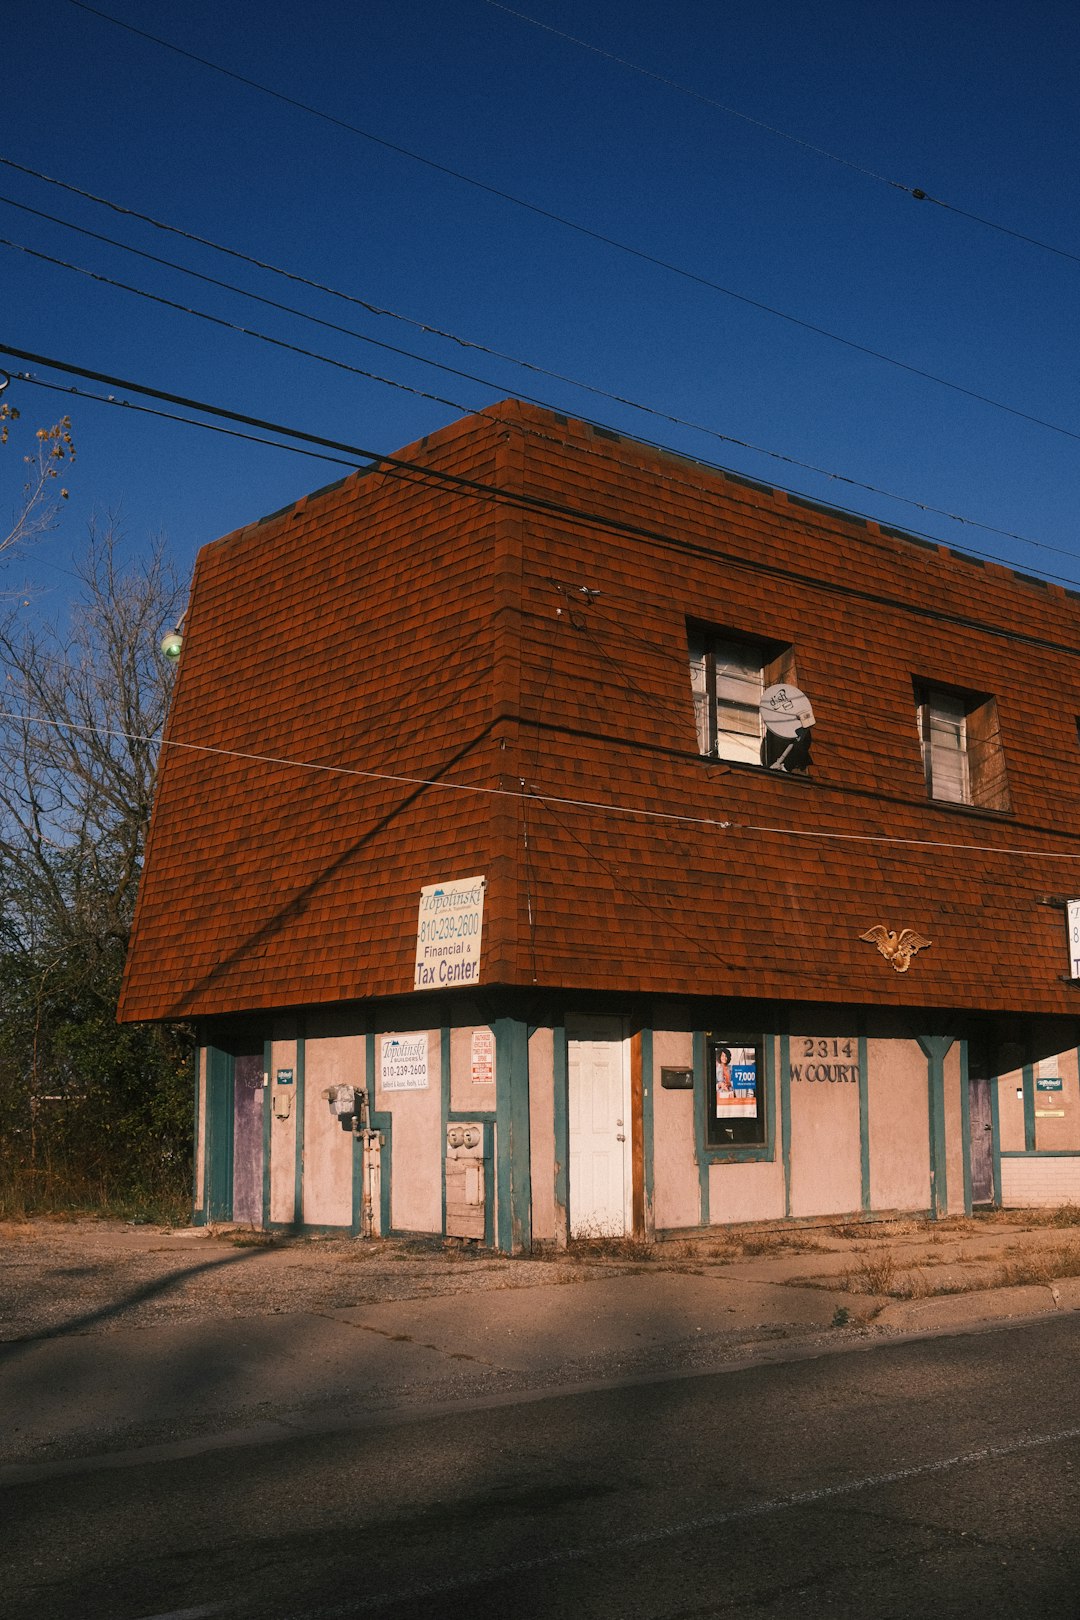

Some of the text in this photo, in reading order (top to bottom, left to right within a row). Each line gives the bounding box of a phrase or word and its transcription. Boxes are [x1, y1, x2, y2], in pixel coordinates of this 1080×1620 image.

[422, 885, 481, 914] Topolinski
[421, 913, 478, 942] 810-239-2600
[424, 942, 471, 958] Financial &
[417, 959, 477, 984] Tax Center
[383, 1039, 426, 1062] Topolinski
[804, 1039, 852, 1058] 2314
[383, 1064, 426, 1077] 810-239-2600
[735, 1072, 755, 1082] $7,000
[805, 1064, 860, 1083] COURT
